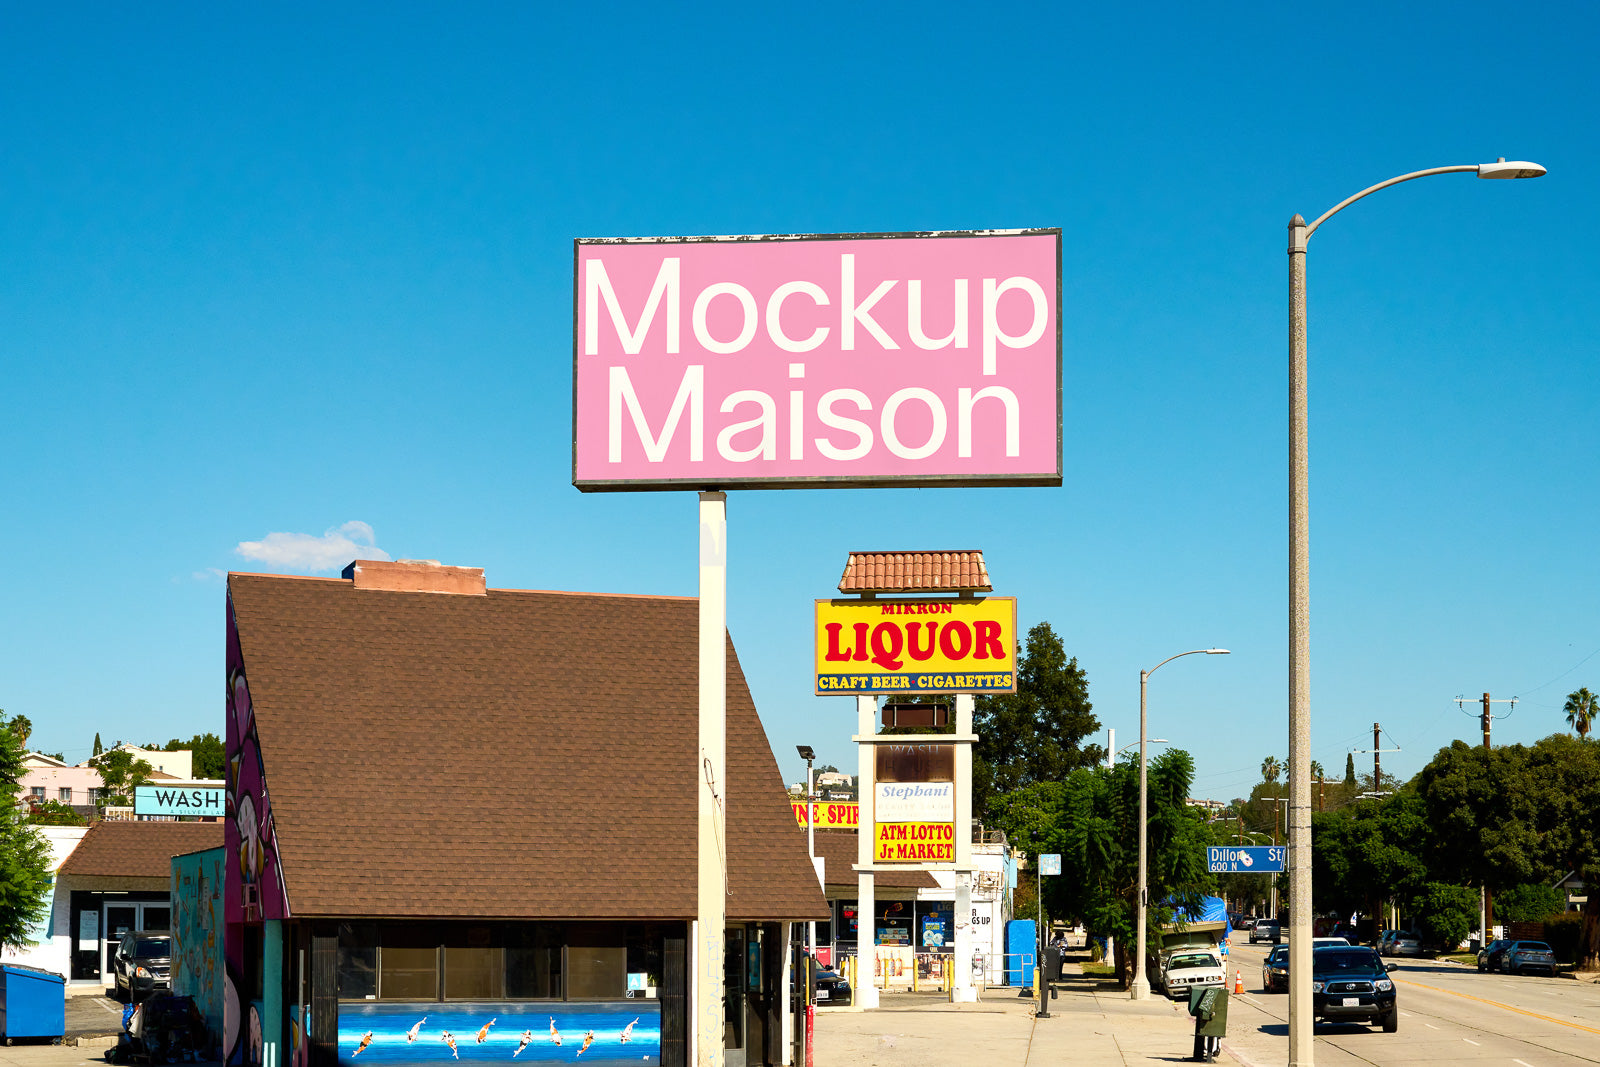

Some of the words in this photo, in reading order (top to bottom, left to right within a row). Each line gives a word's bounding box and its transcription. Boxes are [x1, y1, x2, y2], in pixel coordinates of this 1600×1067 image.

[584, 253, 1049, 376] Mockup
[608, 362, 1020, 463] Maison
[881, 602, 953, 615] MIKRON
[825, 620, 1007, 671] LIQUOR
[818, 676, 869, 689] CRAFT
[871, 676, 910, 688] BEER
[917, 674, 1012, 688] CIGARETTES
[155, 790, 219, 808] WASH
[881, 785, 949, 800] Stephani
[880, 844, 894, 859] Jr
[896, 843, 953, 858] MARKET
[1268, 848, 1281, 861] St
[1211, 862, 1228, 871] 600
[1231, 862, 1238, 871] N
[630, 978, 638, 986] A
